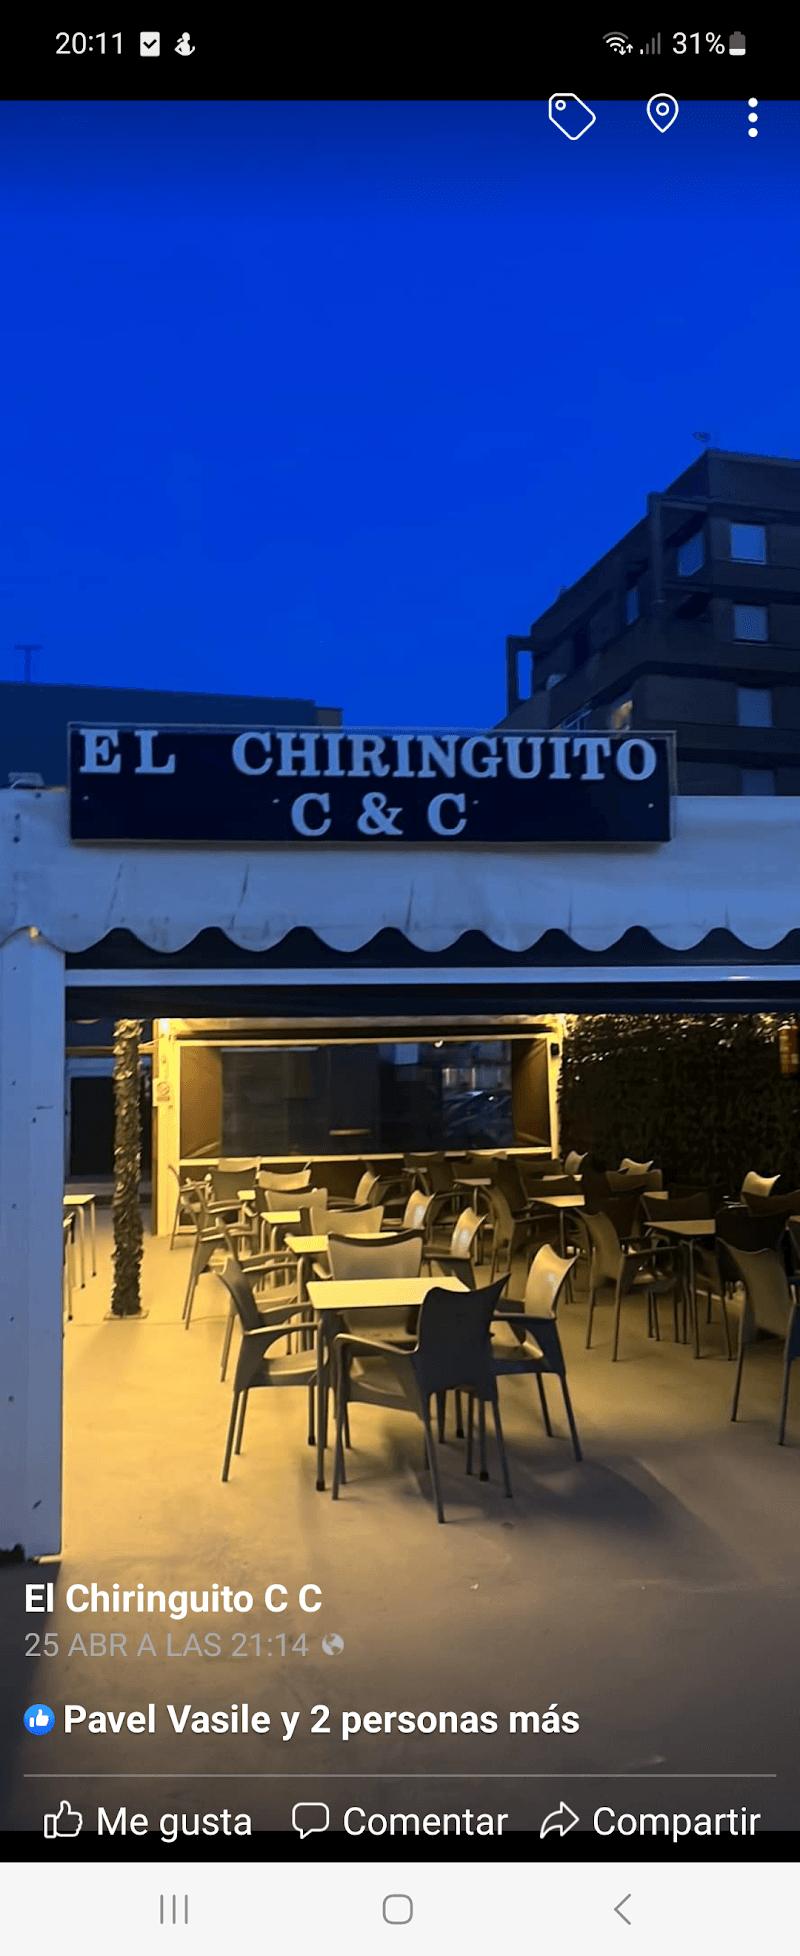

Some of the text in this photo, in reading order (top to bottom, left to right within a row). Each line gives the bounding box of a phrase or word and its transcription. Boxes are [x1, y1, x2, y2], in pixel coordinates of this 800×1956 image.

[79, 728, 657, 781] EL CHIRINGUITO
[291, 792, 468, 837] C & C
